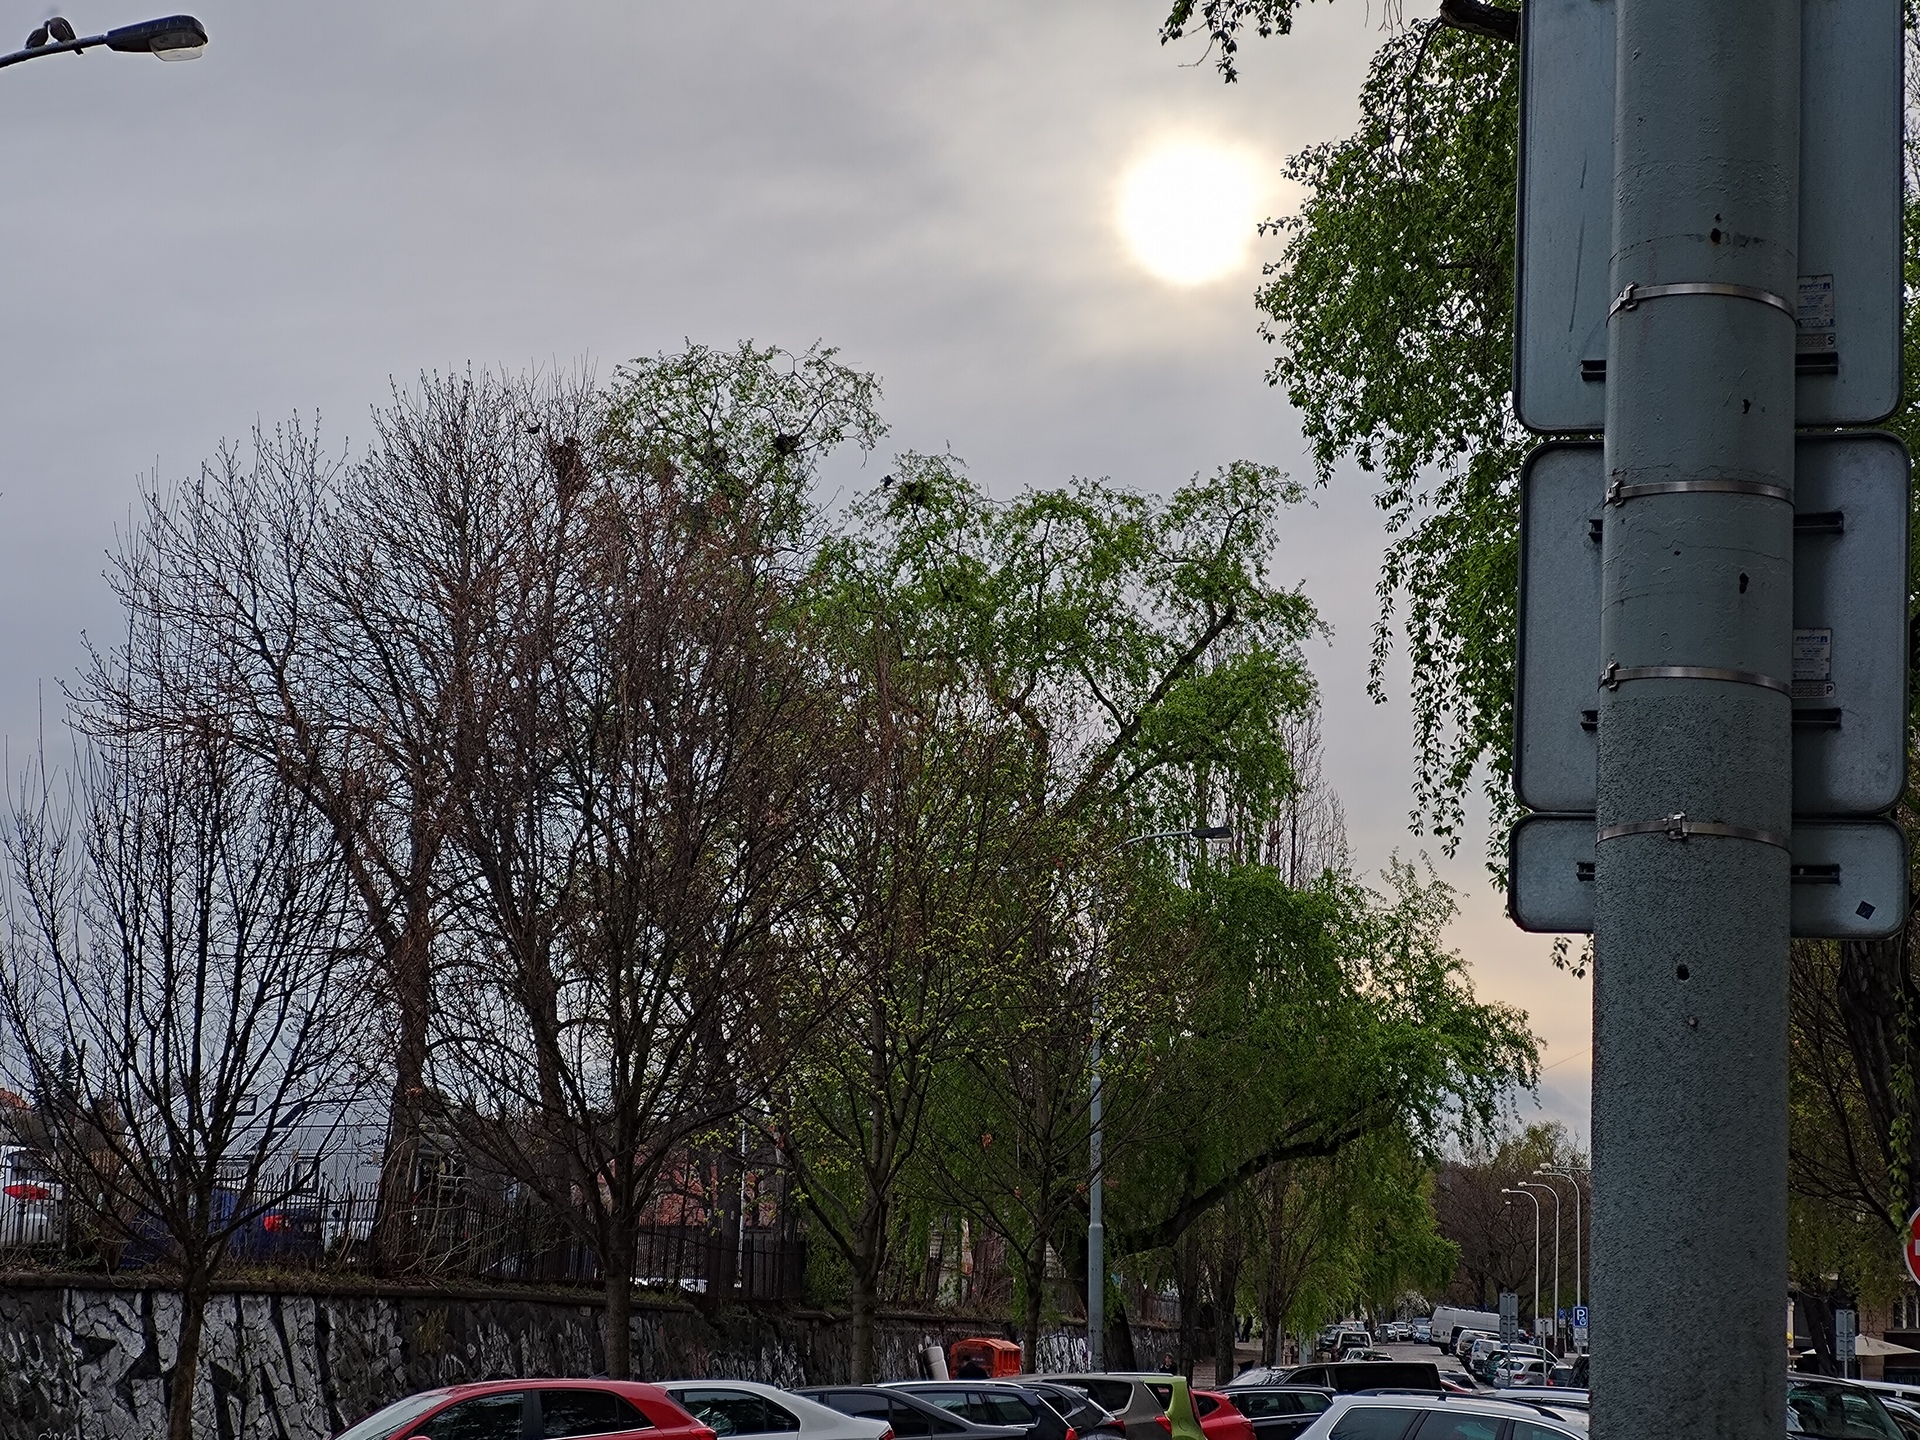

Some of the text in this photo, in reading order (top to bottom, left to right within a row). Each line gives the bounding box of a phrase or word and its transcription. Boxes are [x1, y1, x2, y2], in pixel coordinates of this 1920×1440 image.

[1828, 335, 1835, 345] S
[1826, 685, 1833, 694] P
[1576, 1309, 1585, 1320] P
